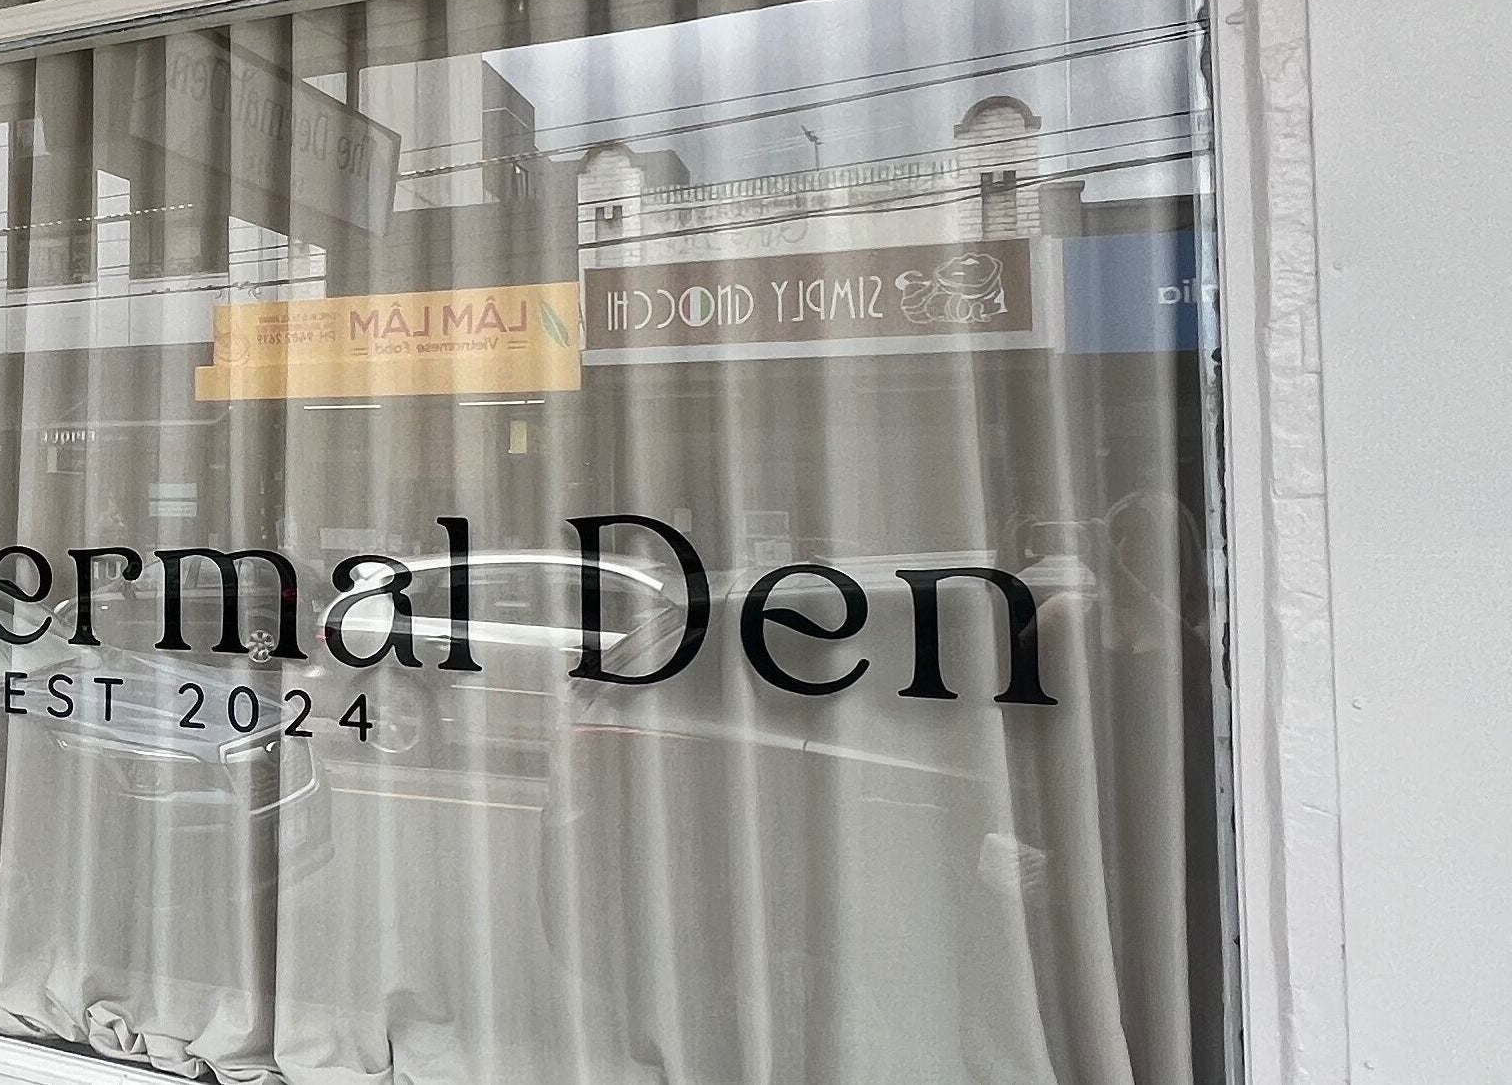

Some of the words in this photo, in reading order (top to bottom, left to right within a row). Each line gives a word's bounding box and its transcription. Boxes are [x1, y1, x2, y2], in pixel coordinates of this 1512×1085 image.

[564, 513, 1059, 706] Den
[3, 671, 124, 722] EST
[177, 682, 374, 742] 2024
